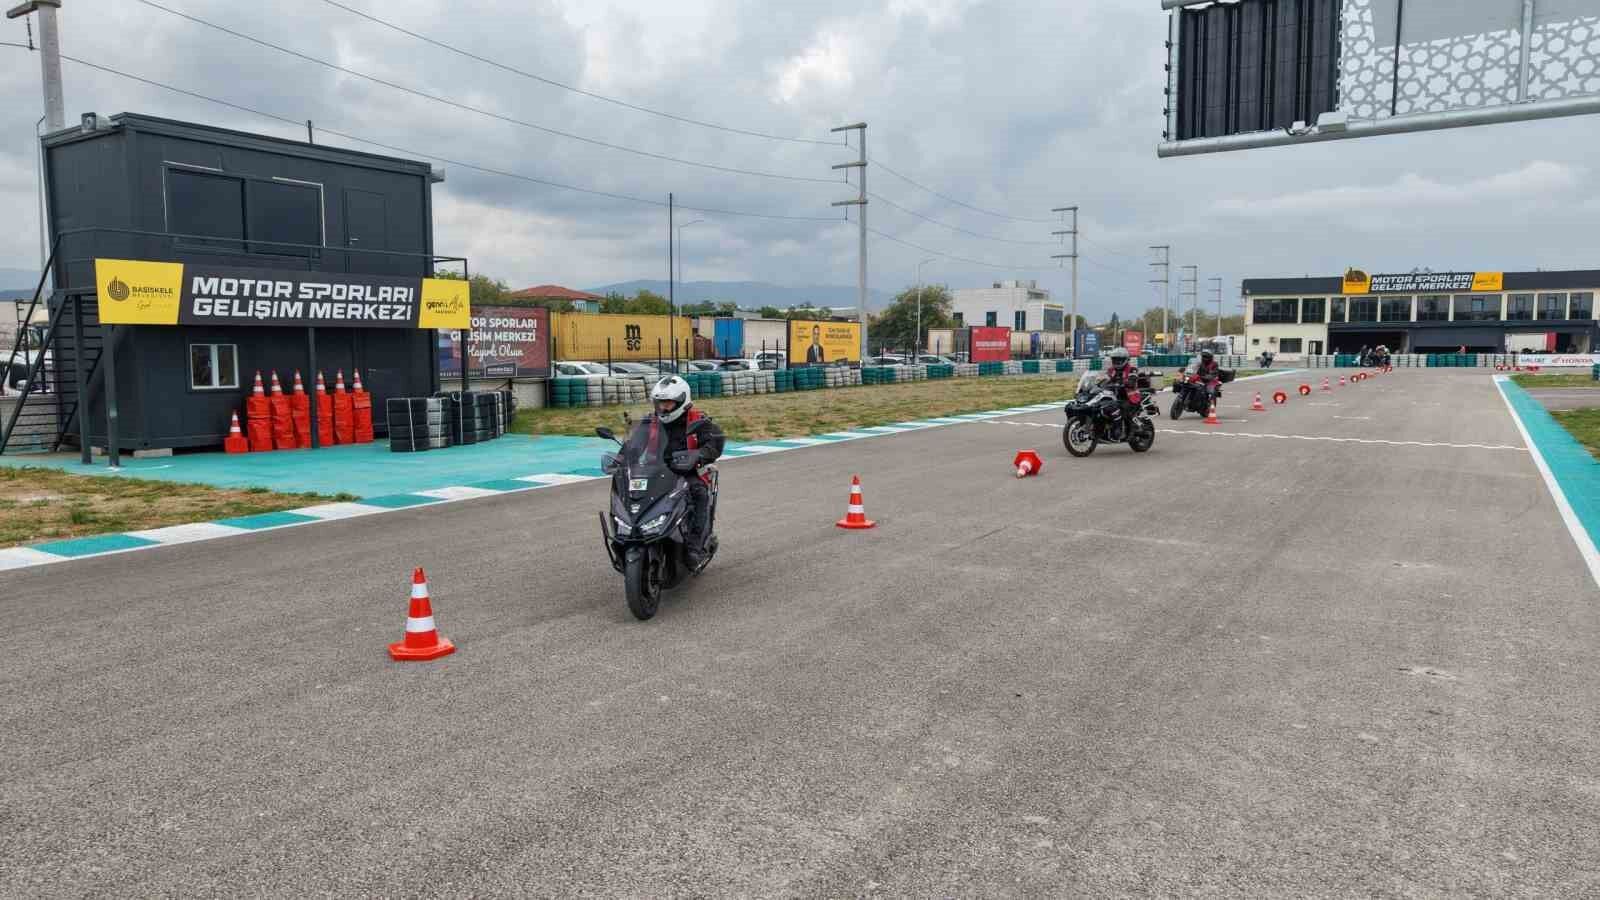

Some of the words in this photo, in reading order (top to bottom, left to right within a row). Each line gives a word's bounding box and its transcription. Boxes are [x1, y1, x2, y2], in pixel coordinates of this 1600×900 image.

[1371, 275, 1413, 284] MOTOR
[1414, 274, 1473, 283] SPORLARI
[191, 276, 293, 299] MOTOR
[298, 282, 414, 303] SPORLARI
[489, 317, 537, 328] SPORLARI
